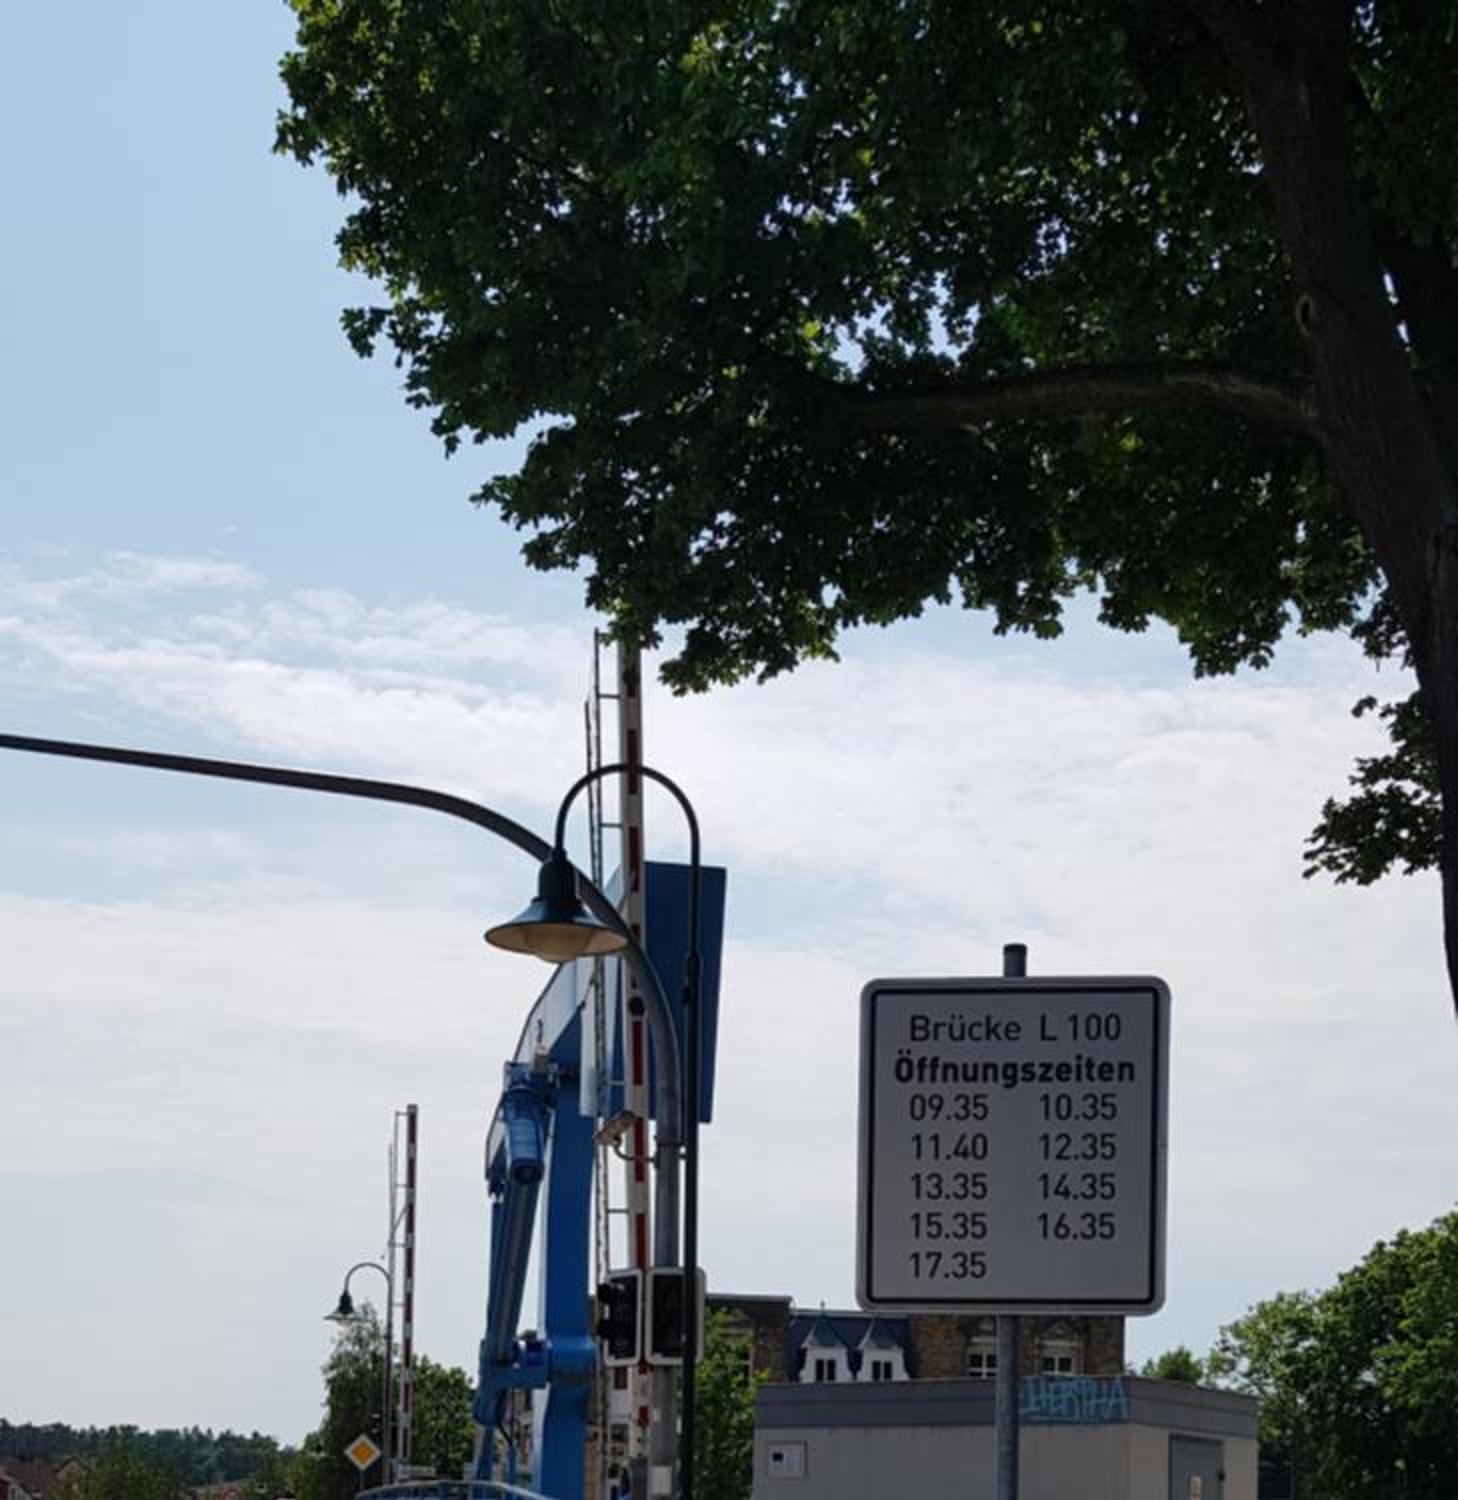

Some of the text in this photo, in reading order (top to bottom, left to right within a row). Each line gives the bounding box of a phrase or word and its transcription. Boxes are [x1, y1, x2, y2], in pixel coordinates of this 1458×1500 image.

[910, 1013, 1021, 1042] Brücke
[894, 1048, 1135, 1089] Öffnungszeiten
[909, 1092, 1118, 1122] 09.35 10.35
[911, 1132, 1117, 1161] 11.40 12.35
[910, 1172, 1116, 1200] 13.35 14.35
[910, 1212, 1116, 1240] 15.35 16.35
[909, 1251, 987, 1280] 17.35
